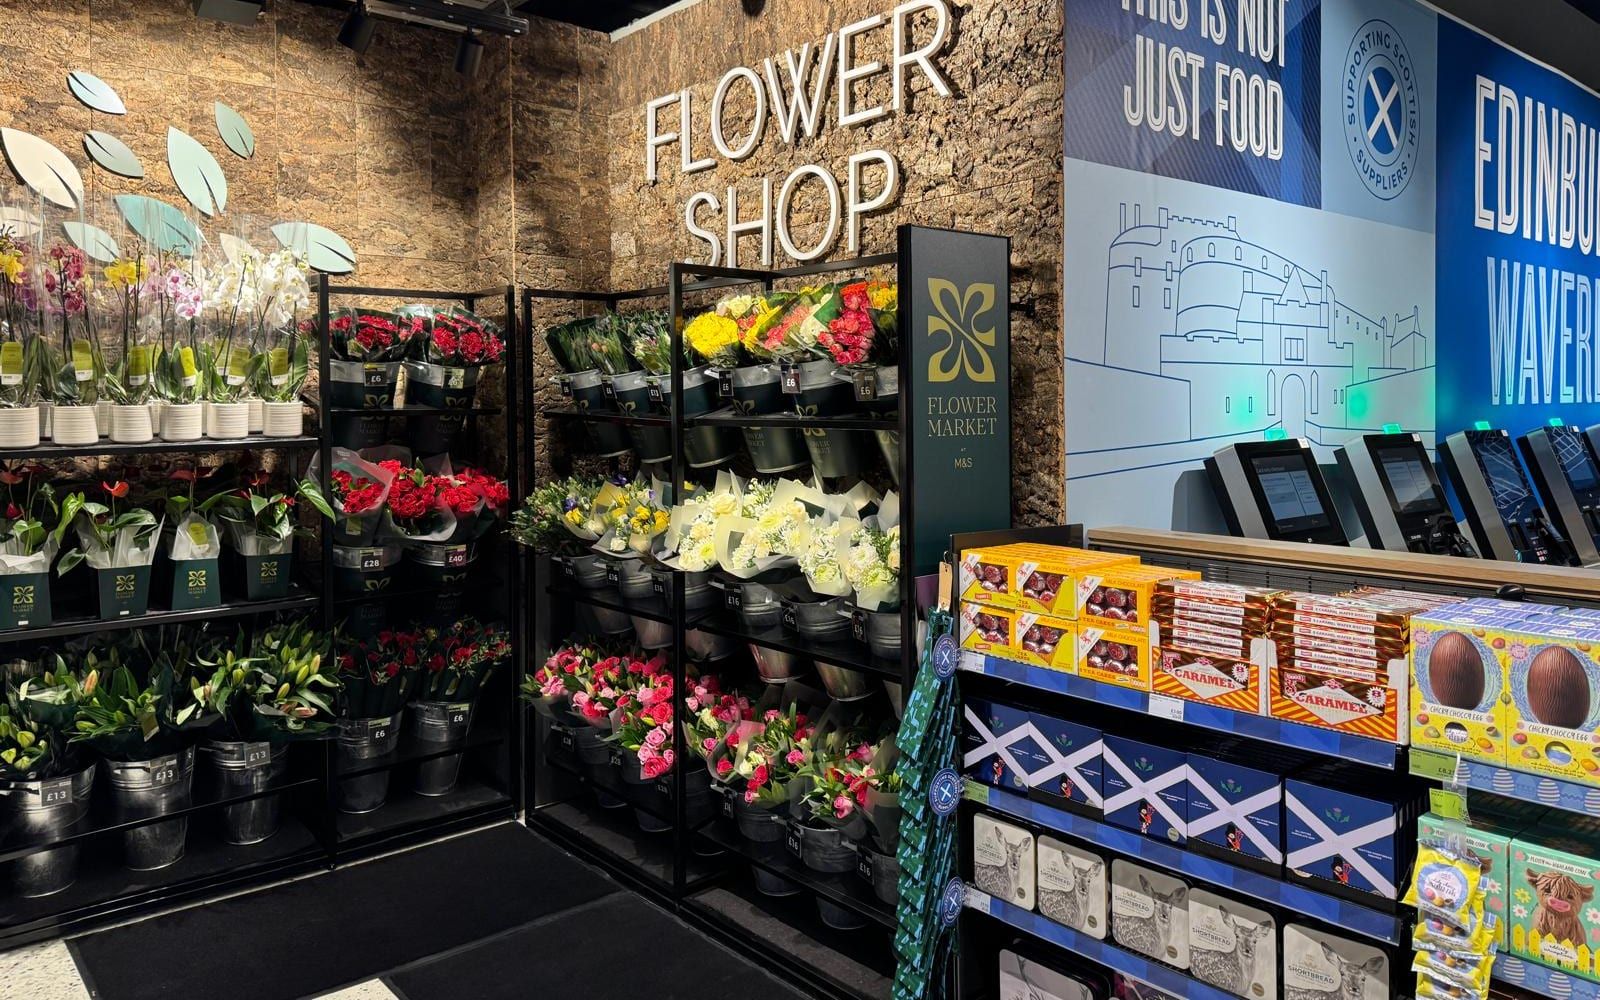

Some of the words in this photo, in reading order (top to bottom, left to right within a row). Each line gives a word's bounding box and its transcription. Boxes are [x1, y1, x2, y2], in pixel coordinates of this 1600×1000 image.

[1238, 0, 1288, 67] NOT
[646, 0, 952, 182] FLOWER
[1348, 30, 1390, 126] SUPPORTING
[1393, 43, 1416, 146] SCOTTISH
[1123, 34, 1204, 140] JUST
[1215, 61, 1284, 161] FOOD
[1356, 149, 1408, 190] SUPPLIERS
[1474, 74, 1600, 257] EDINBU
[684, 150, 899, 272] SHOP
[1487, 256, 1600, 405] WAVER
[371, 375, 381, 383] £6
[786, 378, 796, 387] £6
[860, 386, 871, 395] £6
[927, 396, 997, 414] FLOWER
[928, 418, 997, 437] MARKET
[954, 457, 973, 469] M&S
[364, 560, 380, 568] £28
[448, 555, 463, 563] £40
[728, 596, 740, 606] £16
[1174, 669, 1236, 689] CARAMEL
[1372, 690, 1381, 698] 8
[1296, 692, 1368, 714] CARAMEL
[454, 714, 464, 722] £6
[1449, 709, 1471, 720] CHOCCY
[1472, 713, 1483, 721] EGG
[375, 730, 385, 738] £6
[1528, 724, 1549, 734] CHICKY
[1550, 727, 1574, 740] CHOCCY
[1576, 733, 1588, 741] EGG
[250, 751, 266, 761] £13
[156, 769, 174, 780] £13
[47, 791, 66, 802] £13
[859, 862, 871, 876] £16
[1115, 895, 1150, 912] SHORTBREAD
[1192, 927, 1231, 946] SHORTBREAD
[1288, 965, 1335, 985] SHORTBREAD
